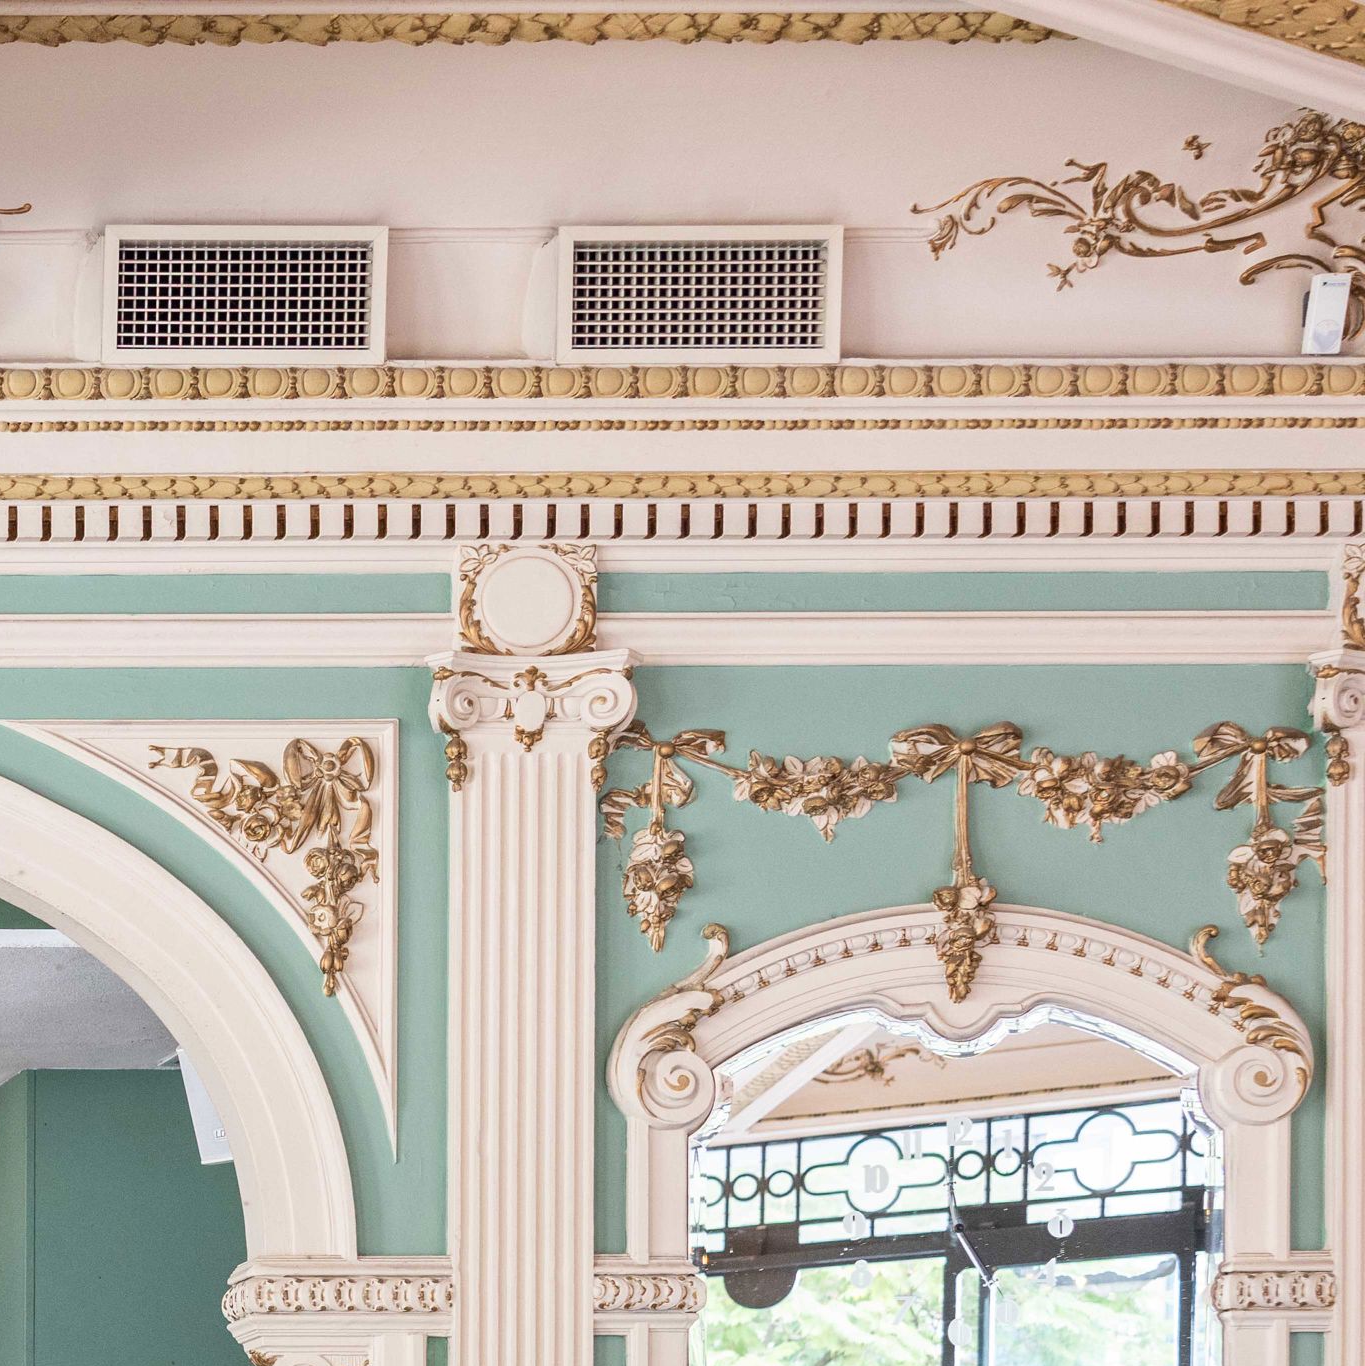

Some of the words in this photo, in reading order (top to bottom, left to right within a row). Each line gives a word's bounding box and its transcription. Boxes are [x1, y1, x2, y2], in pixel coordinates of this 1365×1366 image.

[902, 1131, 923, 1160] 11
[863, 1164, 890, 1194] 10
[1033, 1162, 1056, 1192] 2
[894, 1294, 919, 1325] 7
